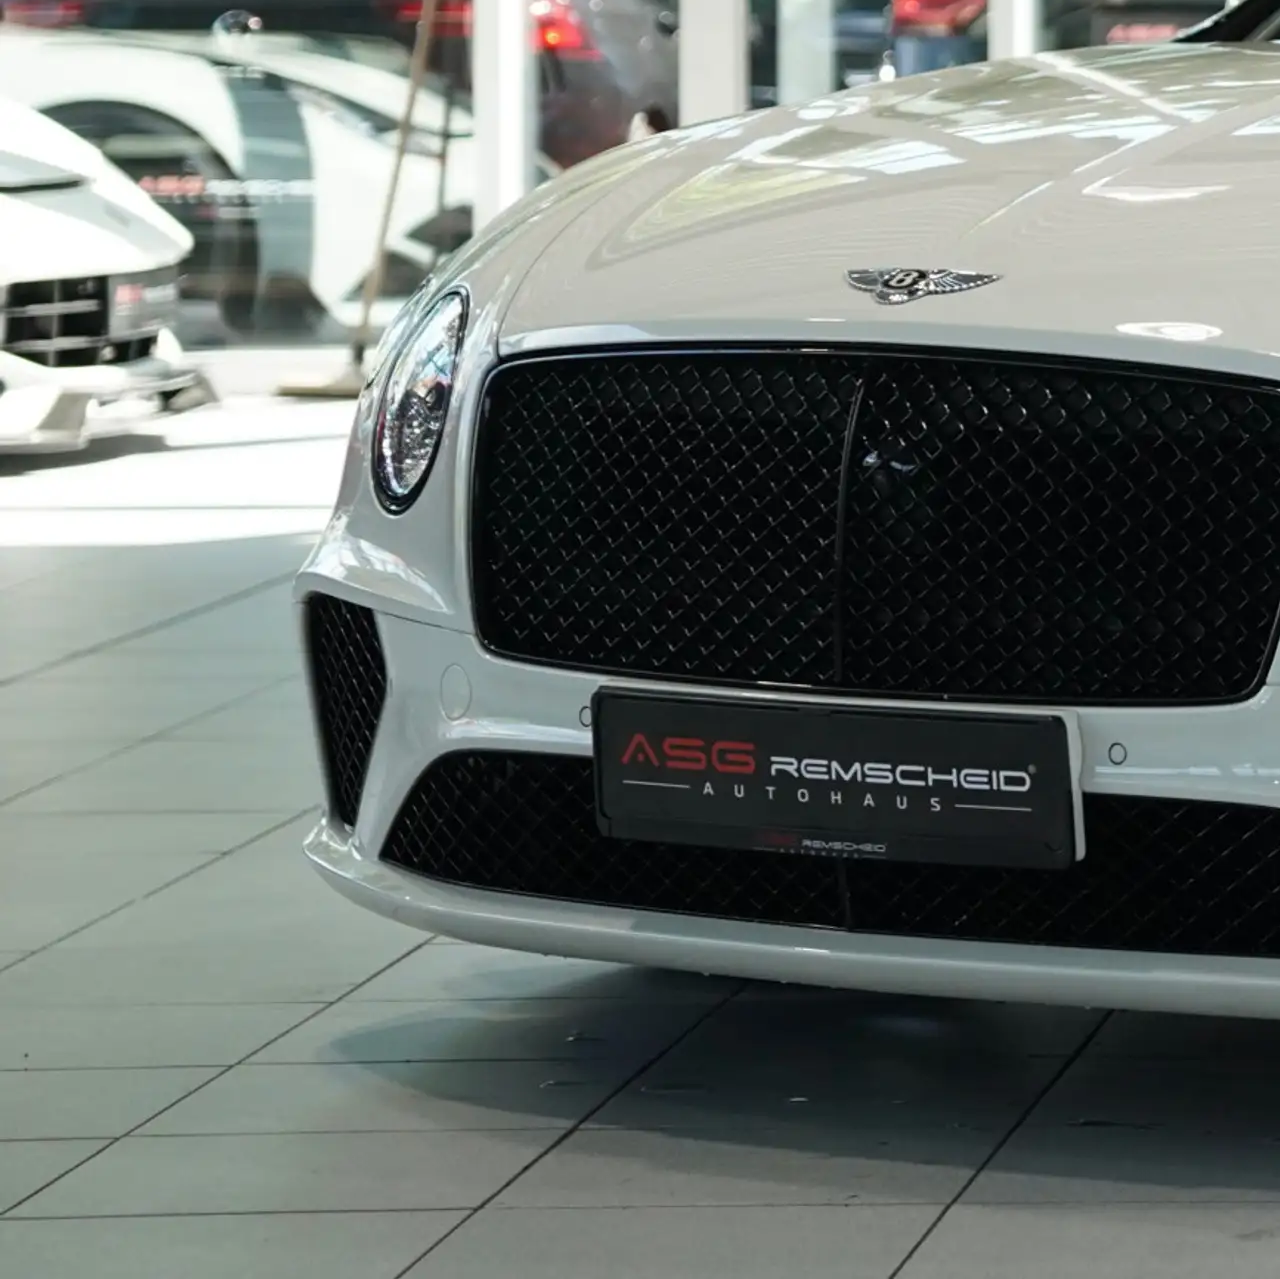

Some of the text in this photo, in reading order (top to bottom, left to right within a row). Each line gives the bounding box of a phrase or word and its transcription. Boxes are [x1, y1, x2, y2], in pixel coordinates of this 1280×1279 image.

[620, 733, 1032, 793] ASG REMSCHEID
[702, 781, 942, 811] AUTOHAUS
